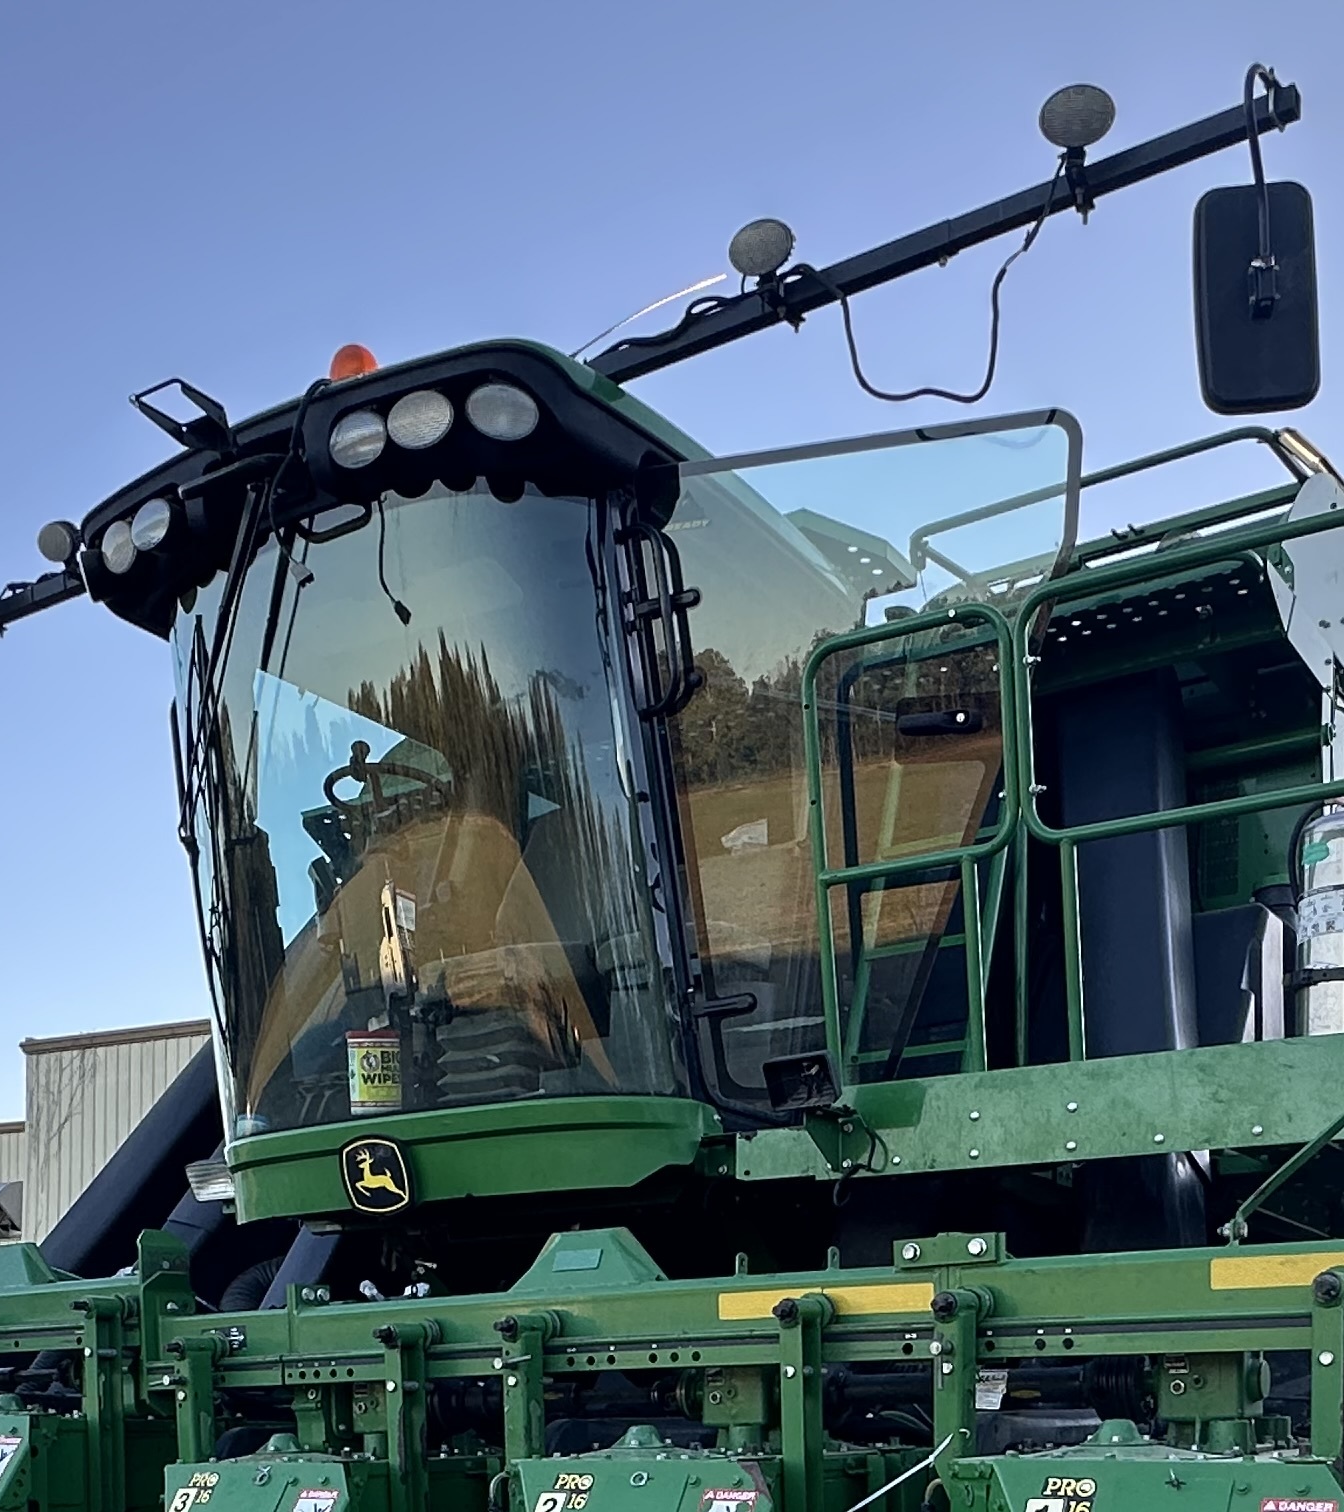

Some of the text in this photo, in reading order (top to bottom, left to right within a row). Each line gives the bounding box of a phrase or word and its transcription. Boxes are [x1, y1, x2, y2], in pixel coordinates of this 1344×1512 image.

[361, 1072, 401, 1085] WIPE
[188, 1472, 219, 1486] PRO
[554, 1474, 593, 1490] PRO
[1043, 1477, 1096, 1497] PRO
[174, 1492, 190, 1512] 3
[195, 1489, 212, 1503] 16
[566, 1493, 588, 1510] 16
[715, 1490, 756, 1500] DANGER
[1278, 1500, 1334, 1512] DANGER
